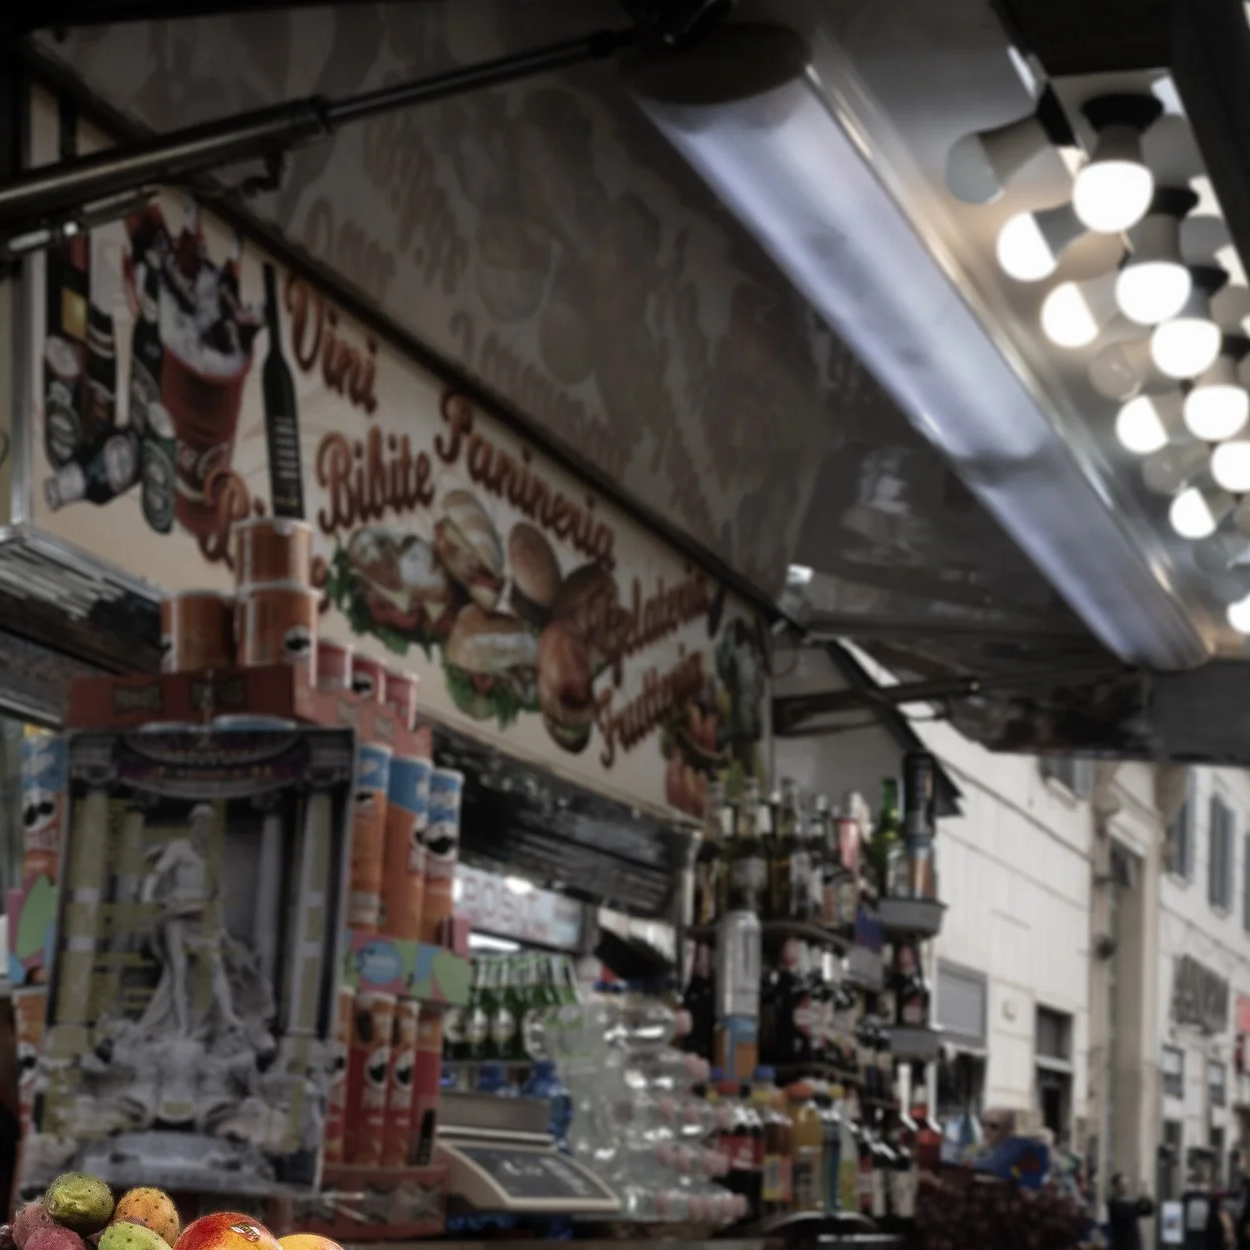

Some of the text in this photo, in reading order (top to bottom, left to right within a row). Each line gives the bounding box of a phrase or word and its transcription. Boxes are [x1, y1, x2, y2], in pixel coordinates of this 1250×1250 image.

[284, 271, 379, 414] Vini
[317, 426, 435, 535] Bibite
[435, 387, 616, 573] Panineria
